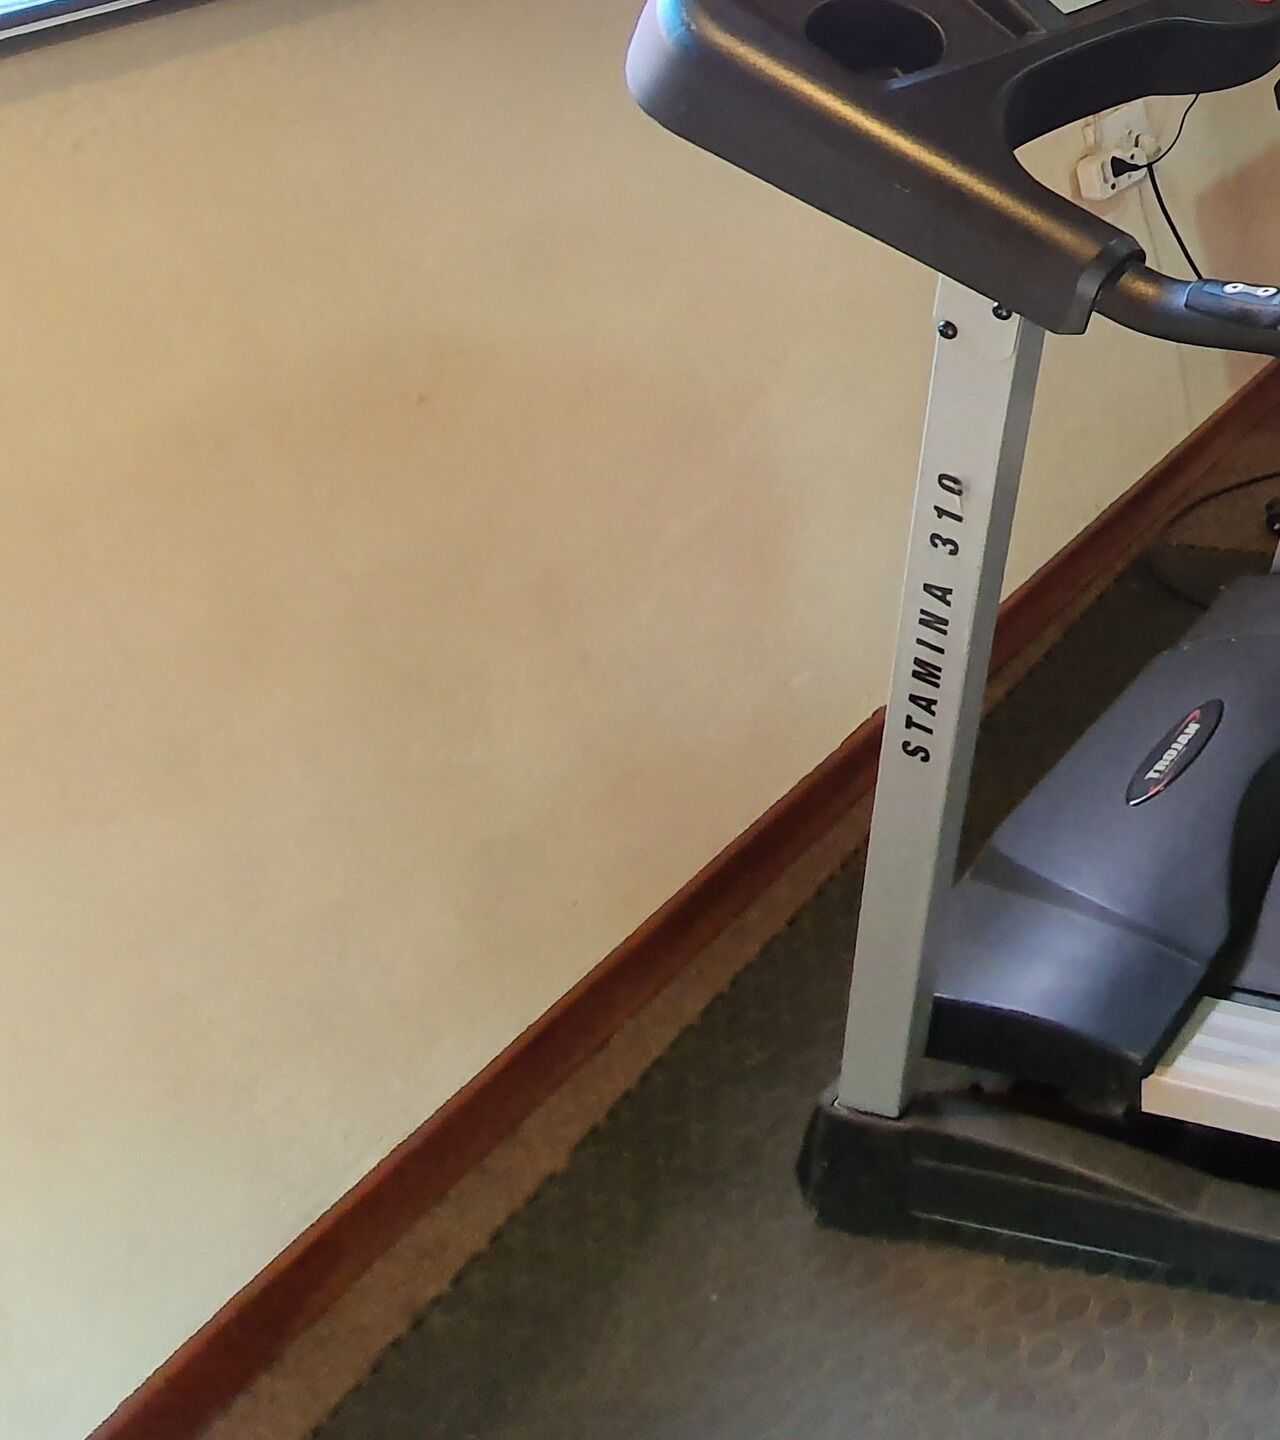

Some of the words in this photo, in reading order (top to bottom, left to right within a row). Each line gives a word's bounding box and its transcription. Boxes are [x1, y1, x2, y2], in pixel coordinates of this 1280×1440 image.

[901, 582, 954, 763] STAMINA
[929, 472, 964, 557] 310
[1143, 720, 1202, 781] TROJAN
